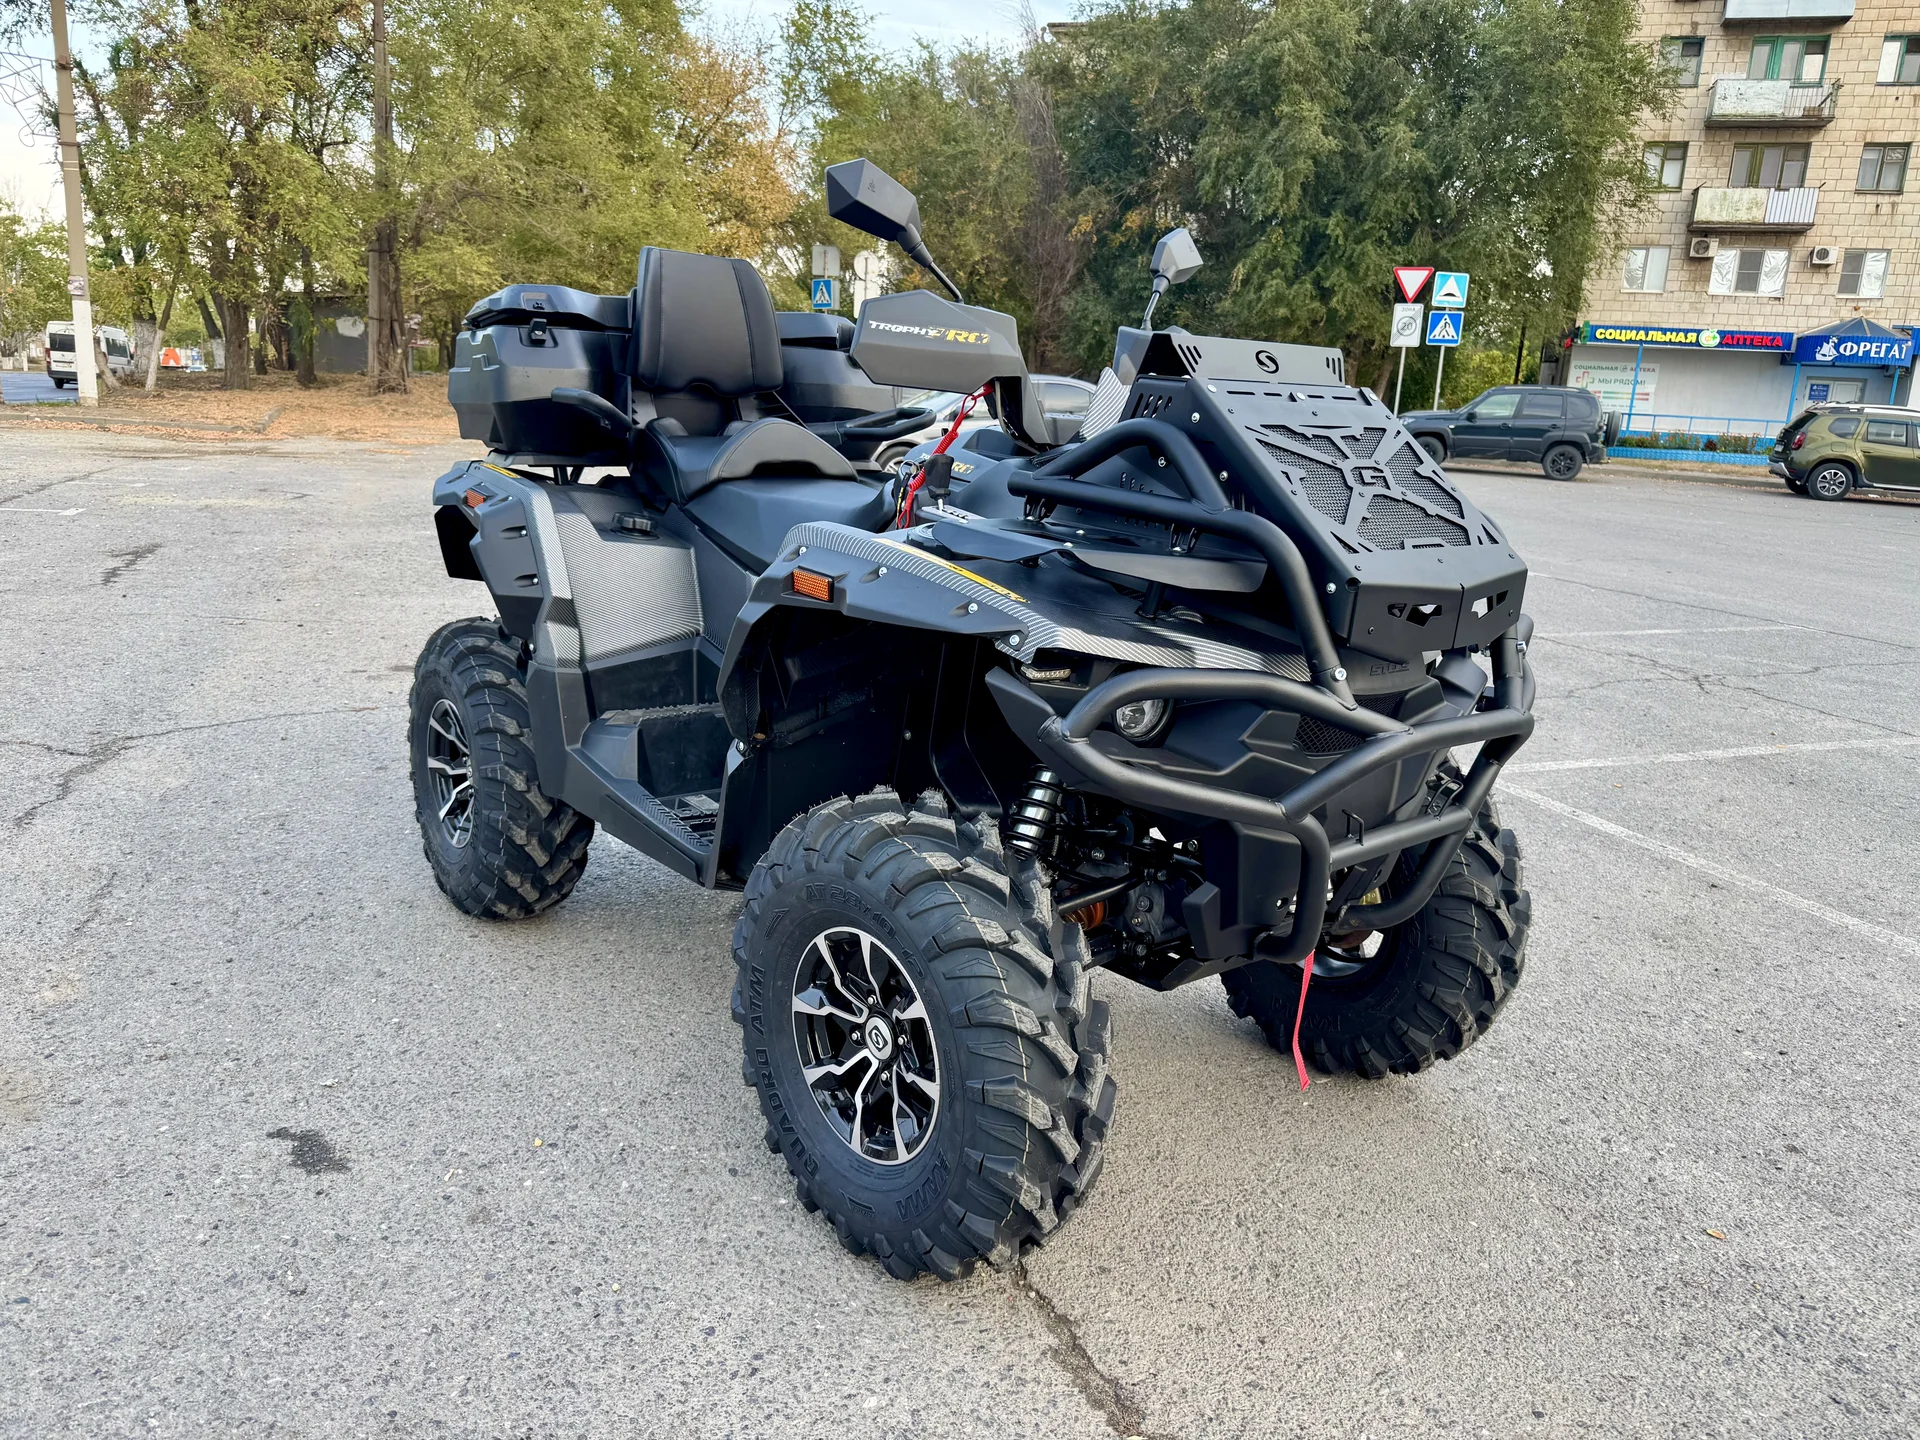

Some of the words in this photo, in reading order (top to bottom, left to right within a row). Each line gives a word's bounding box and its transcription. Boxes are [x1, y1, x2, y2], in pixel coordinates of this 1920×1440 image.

[869, 320, 939, 337] TROPHY
[1400, 322, 1413, 331] 20
[1595, 328, 1698, 344] СОЦИАЛЬНАЯ
[1722, 334, 1783, 348] АПТЕКА
[1839, 341, 1906, 360] ФРЕГАТ
[1573, 364, 1619, 372] СОЦИАЛЬНАЯ
[806, 882, 825, 901] AT
[750, 963, 765, 1037] ATM
[755, 1047, 820, 1179] QUADRO
